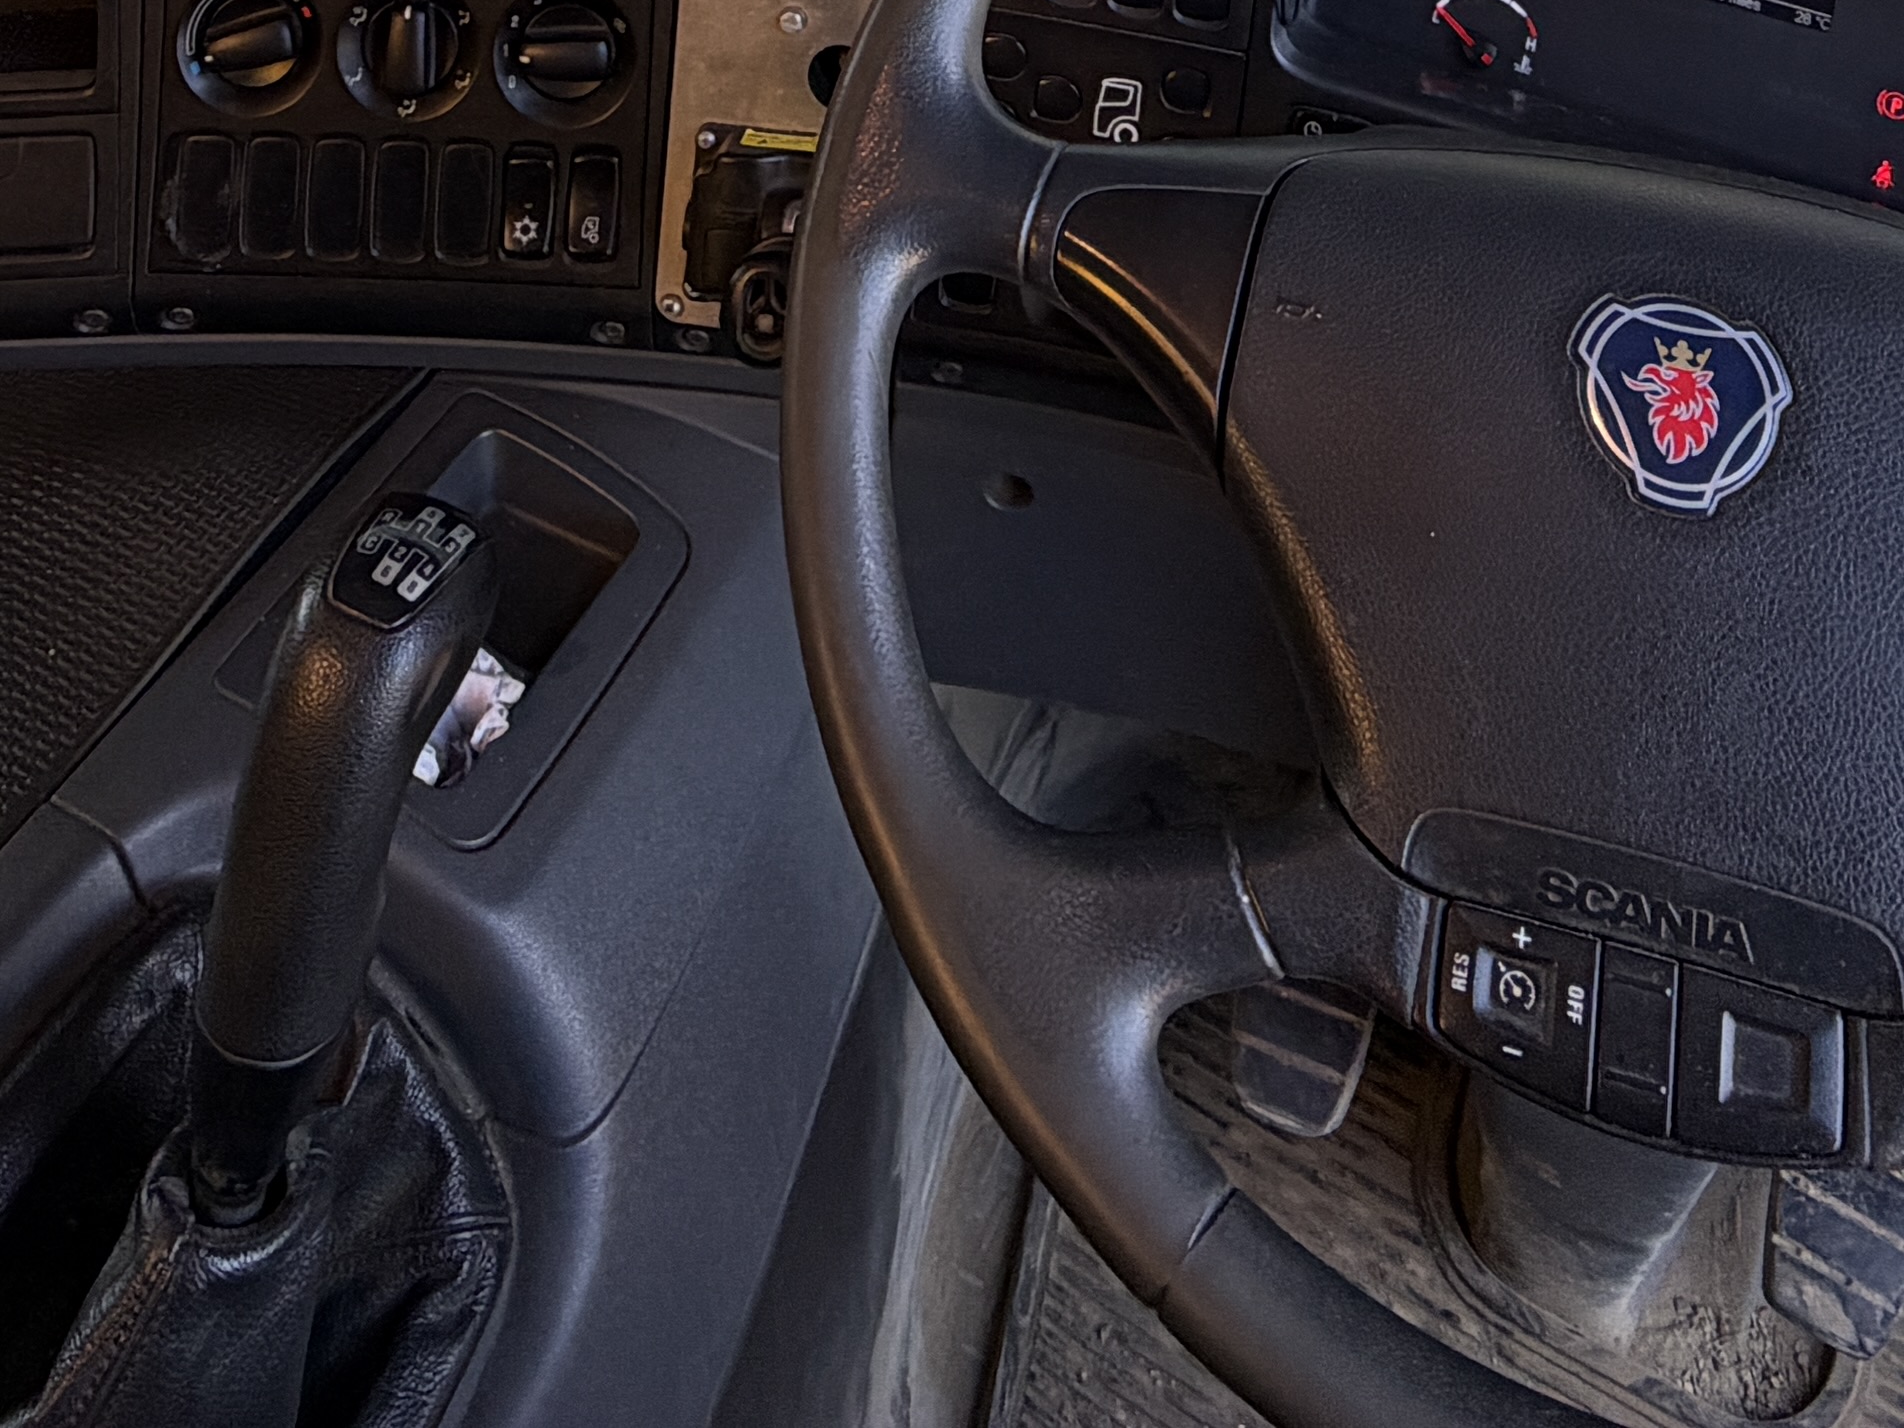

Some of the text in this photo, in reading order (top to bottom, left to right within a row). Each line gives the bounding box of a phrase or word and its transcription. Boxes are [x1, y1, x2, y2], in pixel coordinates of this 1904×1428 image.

[1793, 10, 1812, 26] 28
[380, 565, 393, 578] 6
[1536, 868, 1755, 966] SCANIA
[1450, 952, 1470, 992] RES
[1566, 984, 1586, 1026] OFF
